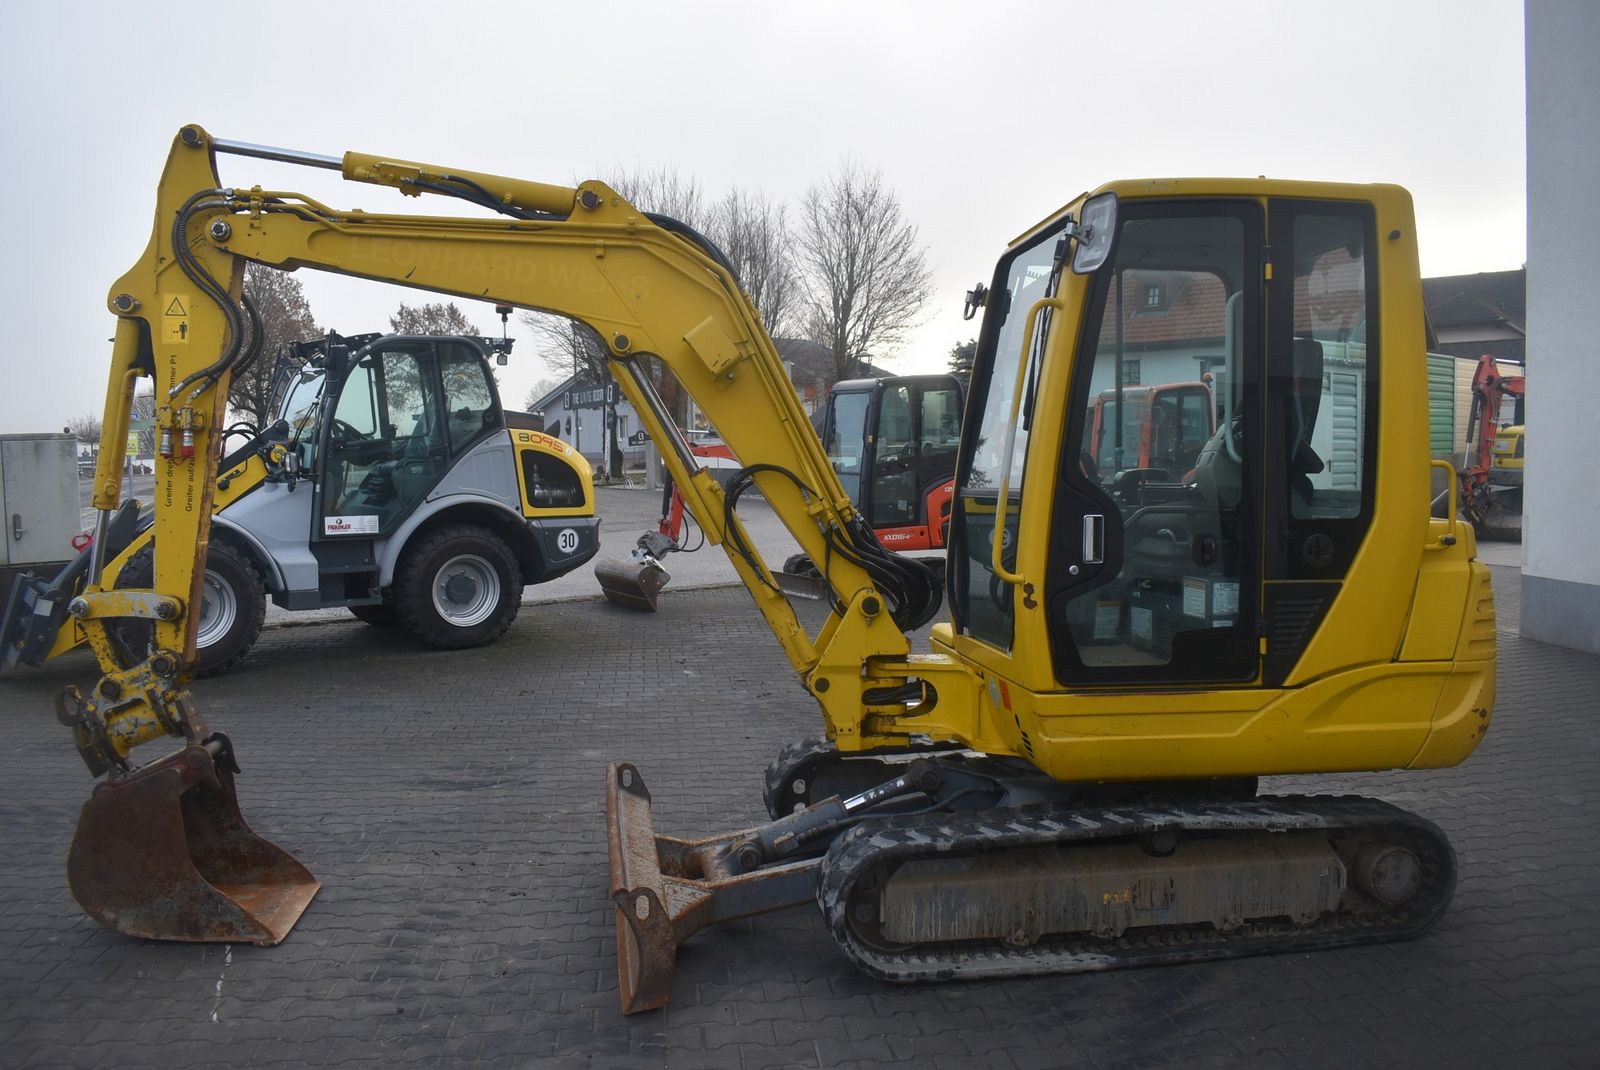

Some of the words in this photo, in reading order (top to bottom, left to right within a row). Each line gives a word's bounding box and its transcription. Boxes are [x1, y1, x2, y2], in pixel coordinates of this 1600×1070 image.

[350, 239, 536, 282] LEONHARD
[165, 479, 173, 507] Greifer
[170, 354, 177, 365] P1
[518, 432, 563, 453] 8095
[185, 484, 194, 512] Greifer
[561, 532, 575, 548] 30
